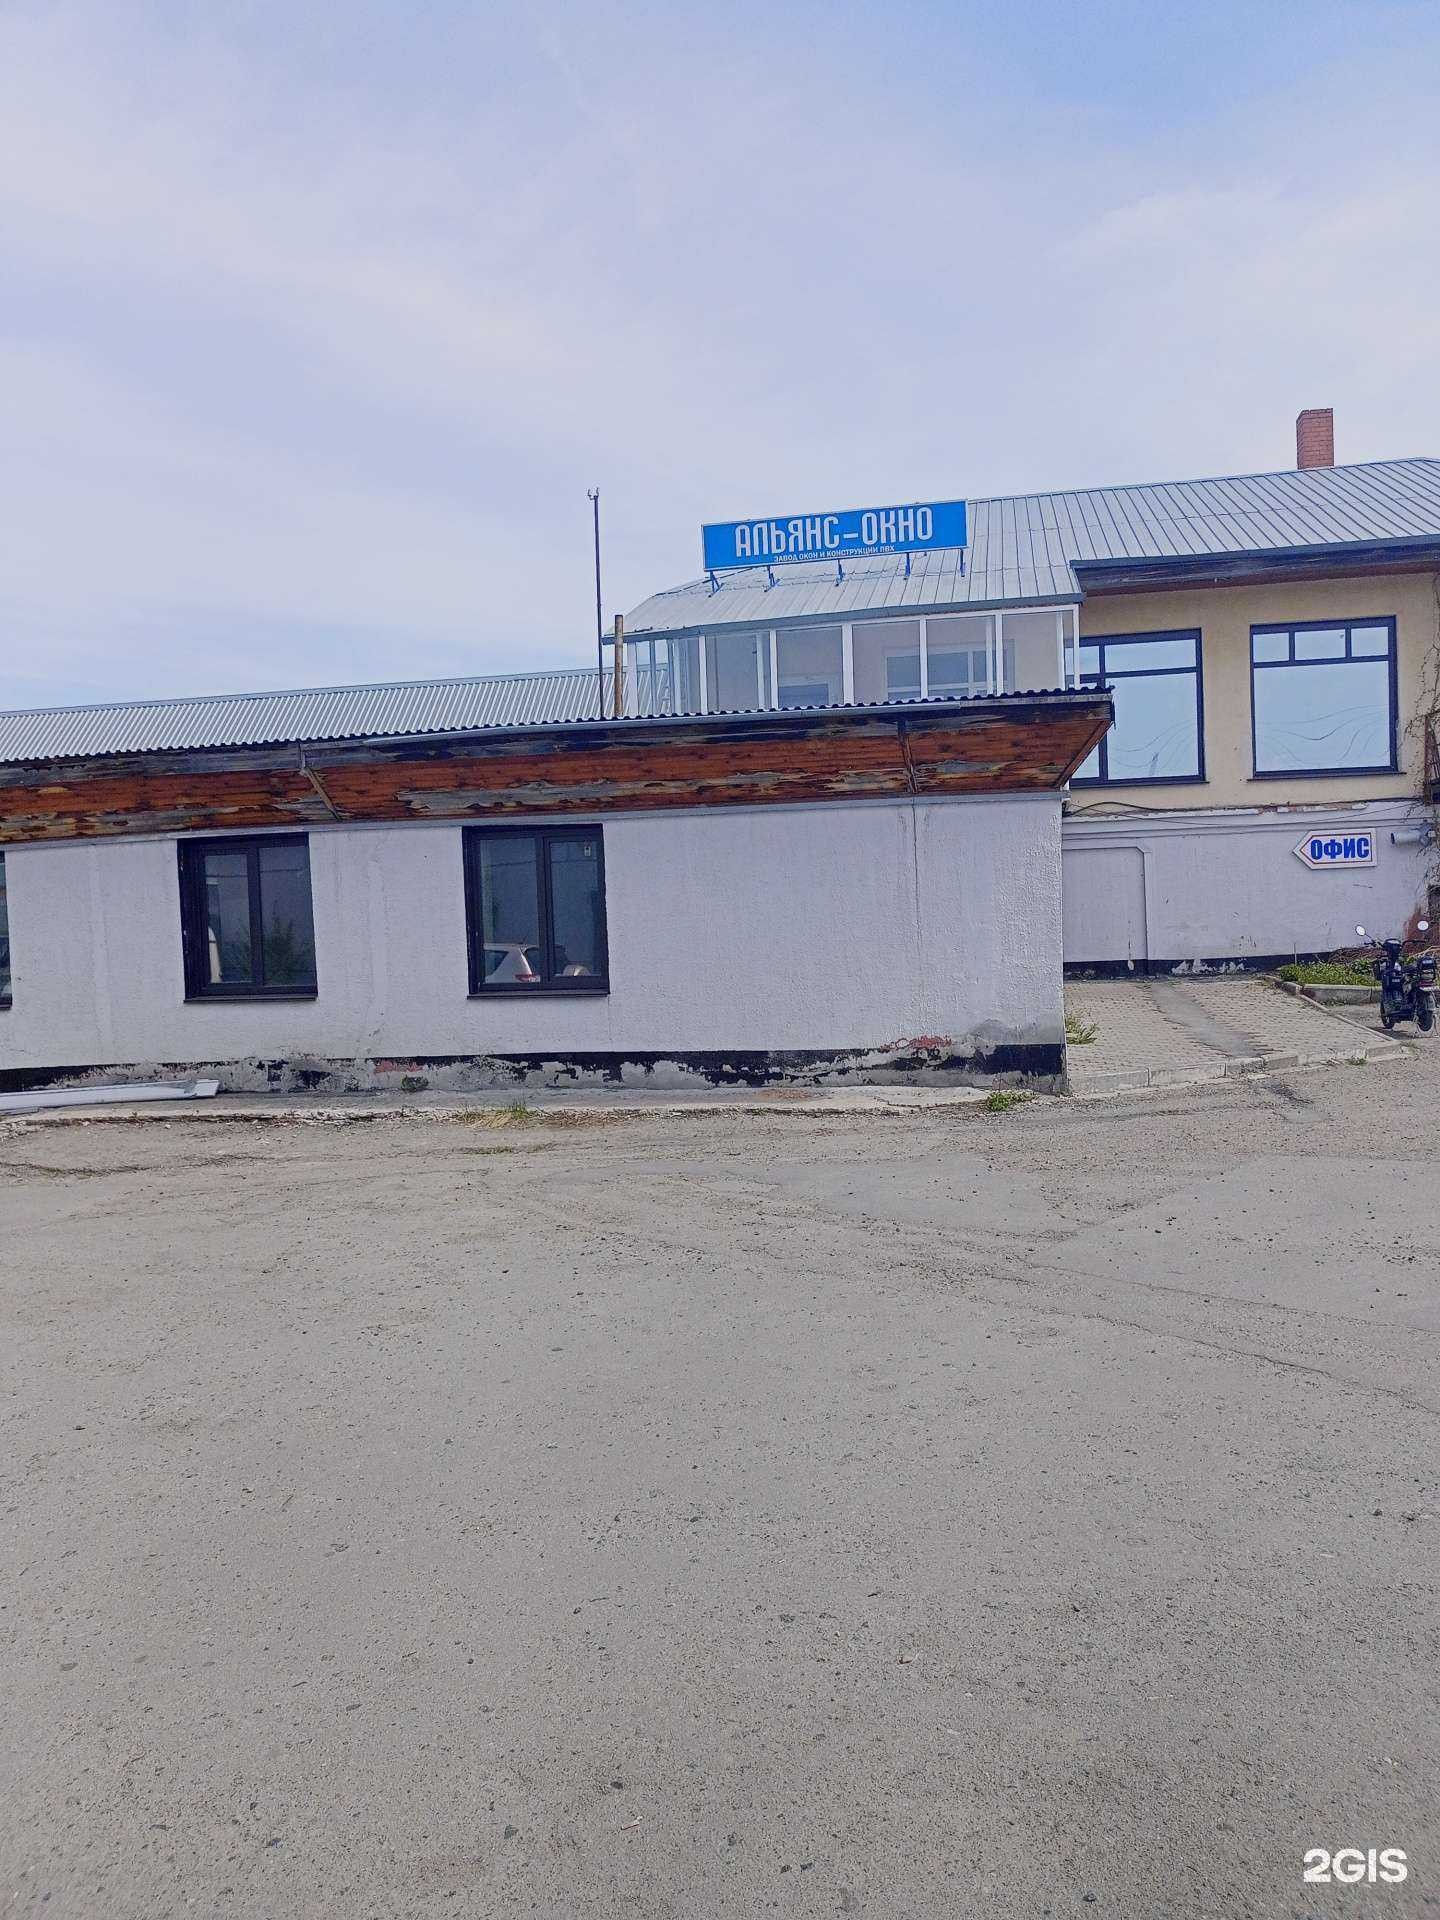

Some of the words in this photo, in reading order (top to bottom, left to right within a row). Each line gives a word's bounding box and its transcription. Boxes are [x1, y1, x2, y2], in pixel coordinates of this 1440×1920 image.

[735, 506, 933, 558] АЛЬЯНС-ОКНО
[775, 554, 798, 562] ЗАВОД
[799, 552, 818, 560] ОКОН
[826, 546, 878, 558] КОНСТРУКЦИИ
[1310, 837, 1370, 860] ОФИС
